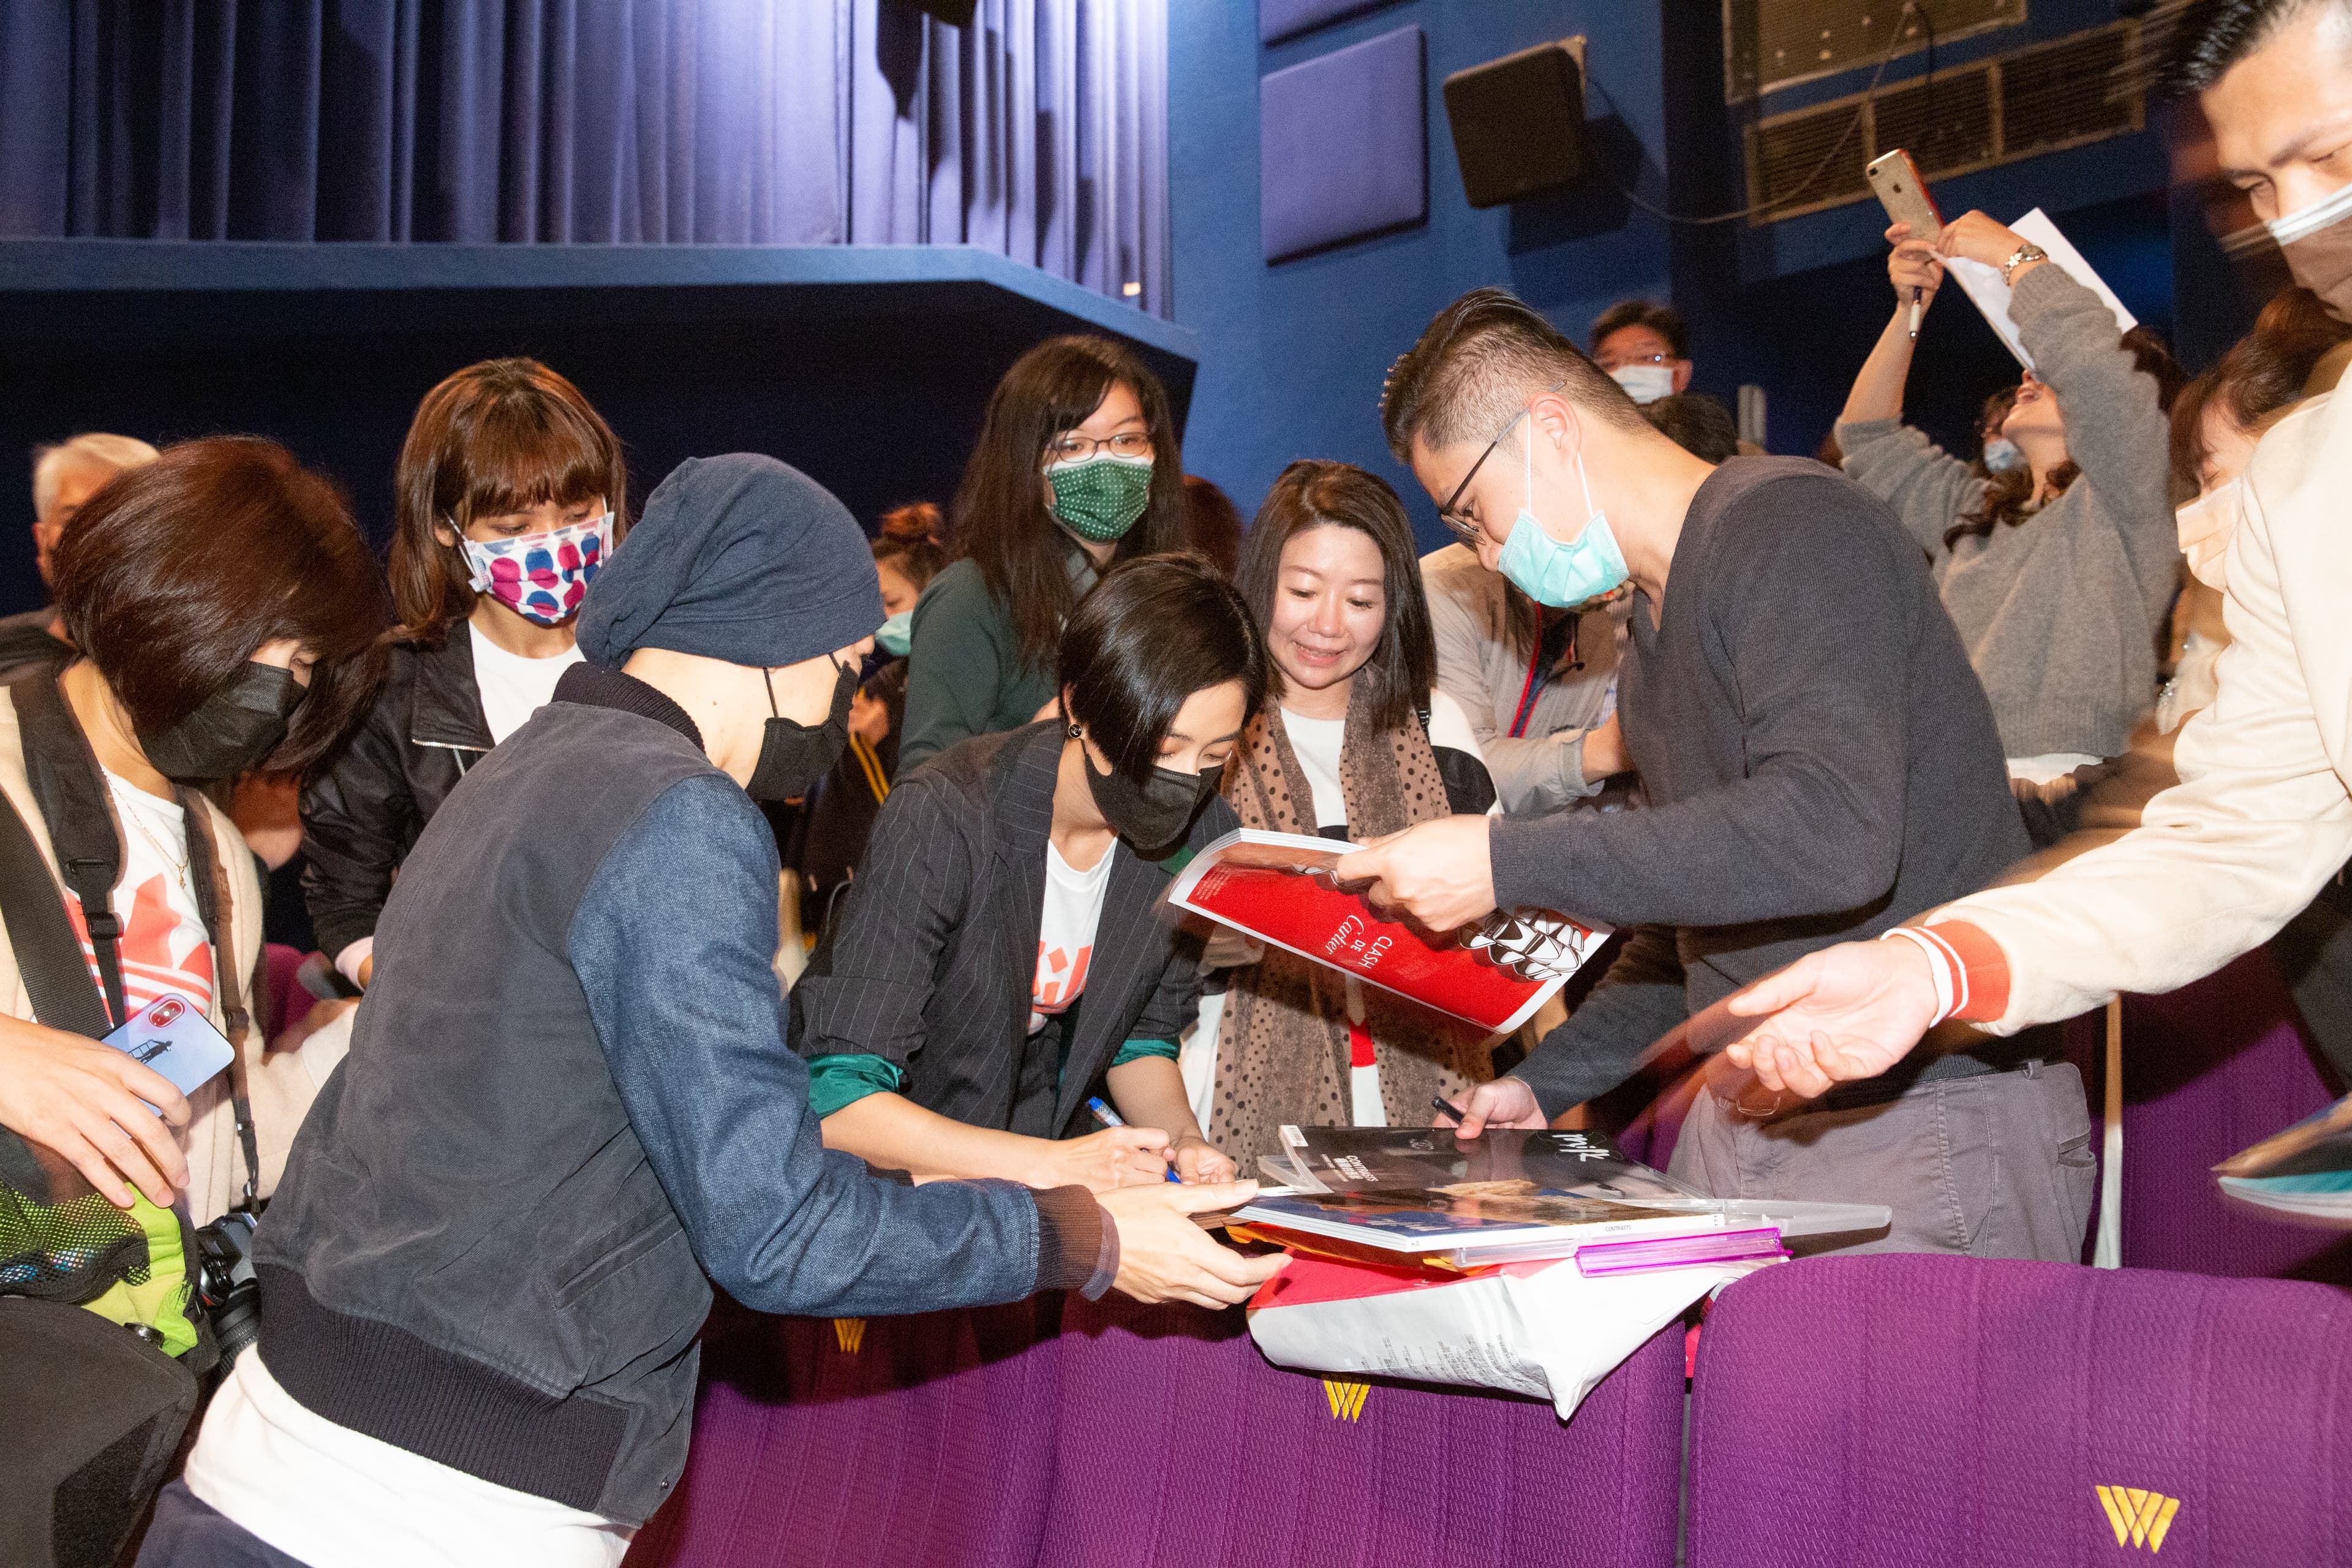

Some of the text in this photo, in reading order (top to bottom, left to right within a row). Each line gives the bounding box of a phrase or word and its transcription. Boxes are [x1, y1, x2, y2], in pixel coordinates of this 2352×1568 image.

[1325, 915, 1364, 955] Cartier
[1350, 939, 1366, 952] DE
[1358, 936, 1393, 969] CLASH
[1347, 1155, 1379, 1182] CONTRASTS
